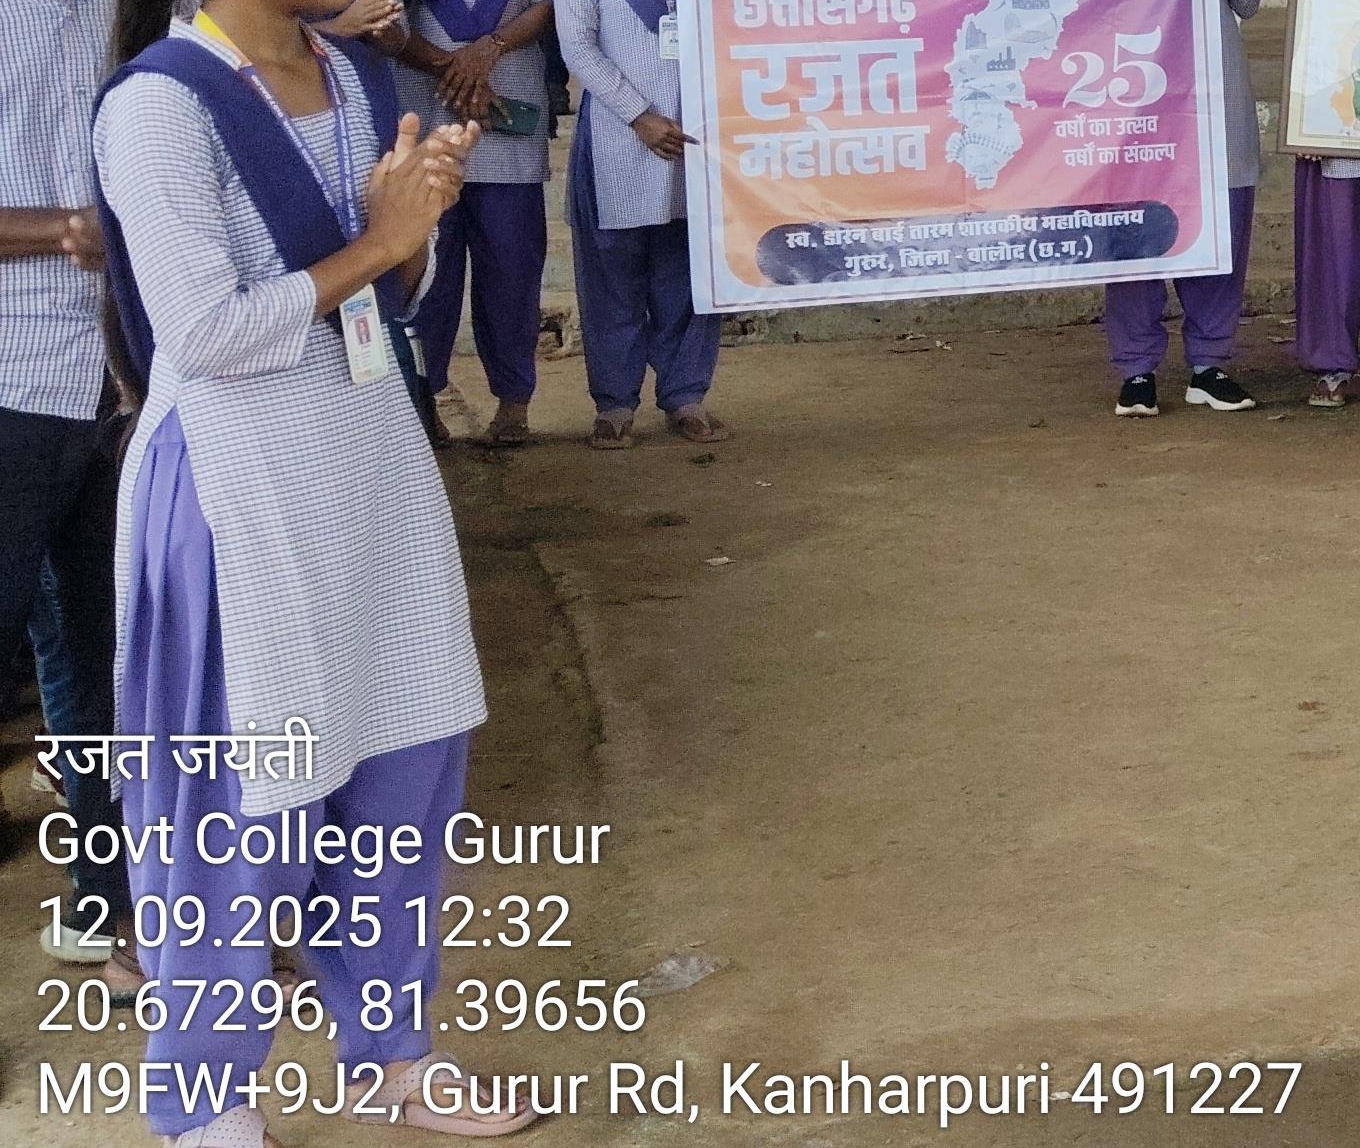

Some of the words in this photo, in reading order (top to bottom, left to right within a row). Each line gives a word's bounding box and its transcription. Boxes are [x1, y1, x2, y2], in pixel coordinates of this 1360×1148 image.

[729, 37, 924, 121] रजत
[1061, 25, 1167, 108] 25
[1054, 113, 1086, 138] वर्षों
[1087, 118, 1112, 136] का
[1113, 115, 1158, 135] उत्सव
[733, 115, 931, 180] महोत्सव
[1062, 141, 1095, 167] वर्षों
[1096, 146, 1120, 165] का
[1123, 140, 1177, 164] संकल्प
[870, 220, 904, 243] बाई
[908, 221, 955, 240] तारम
[957, 214, 1038, 237] शासकीय
[1041, 209, 1146, 231] महाविद्यालय
[899, 247, 952, 269] जिला
